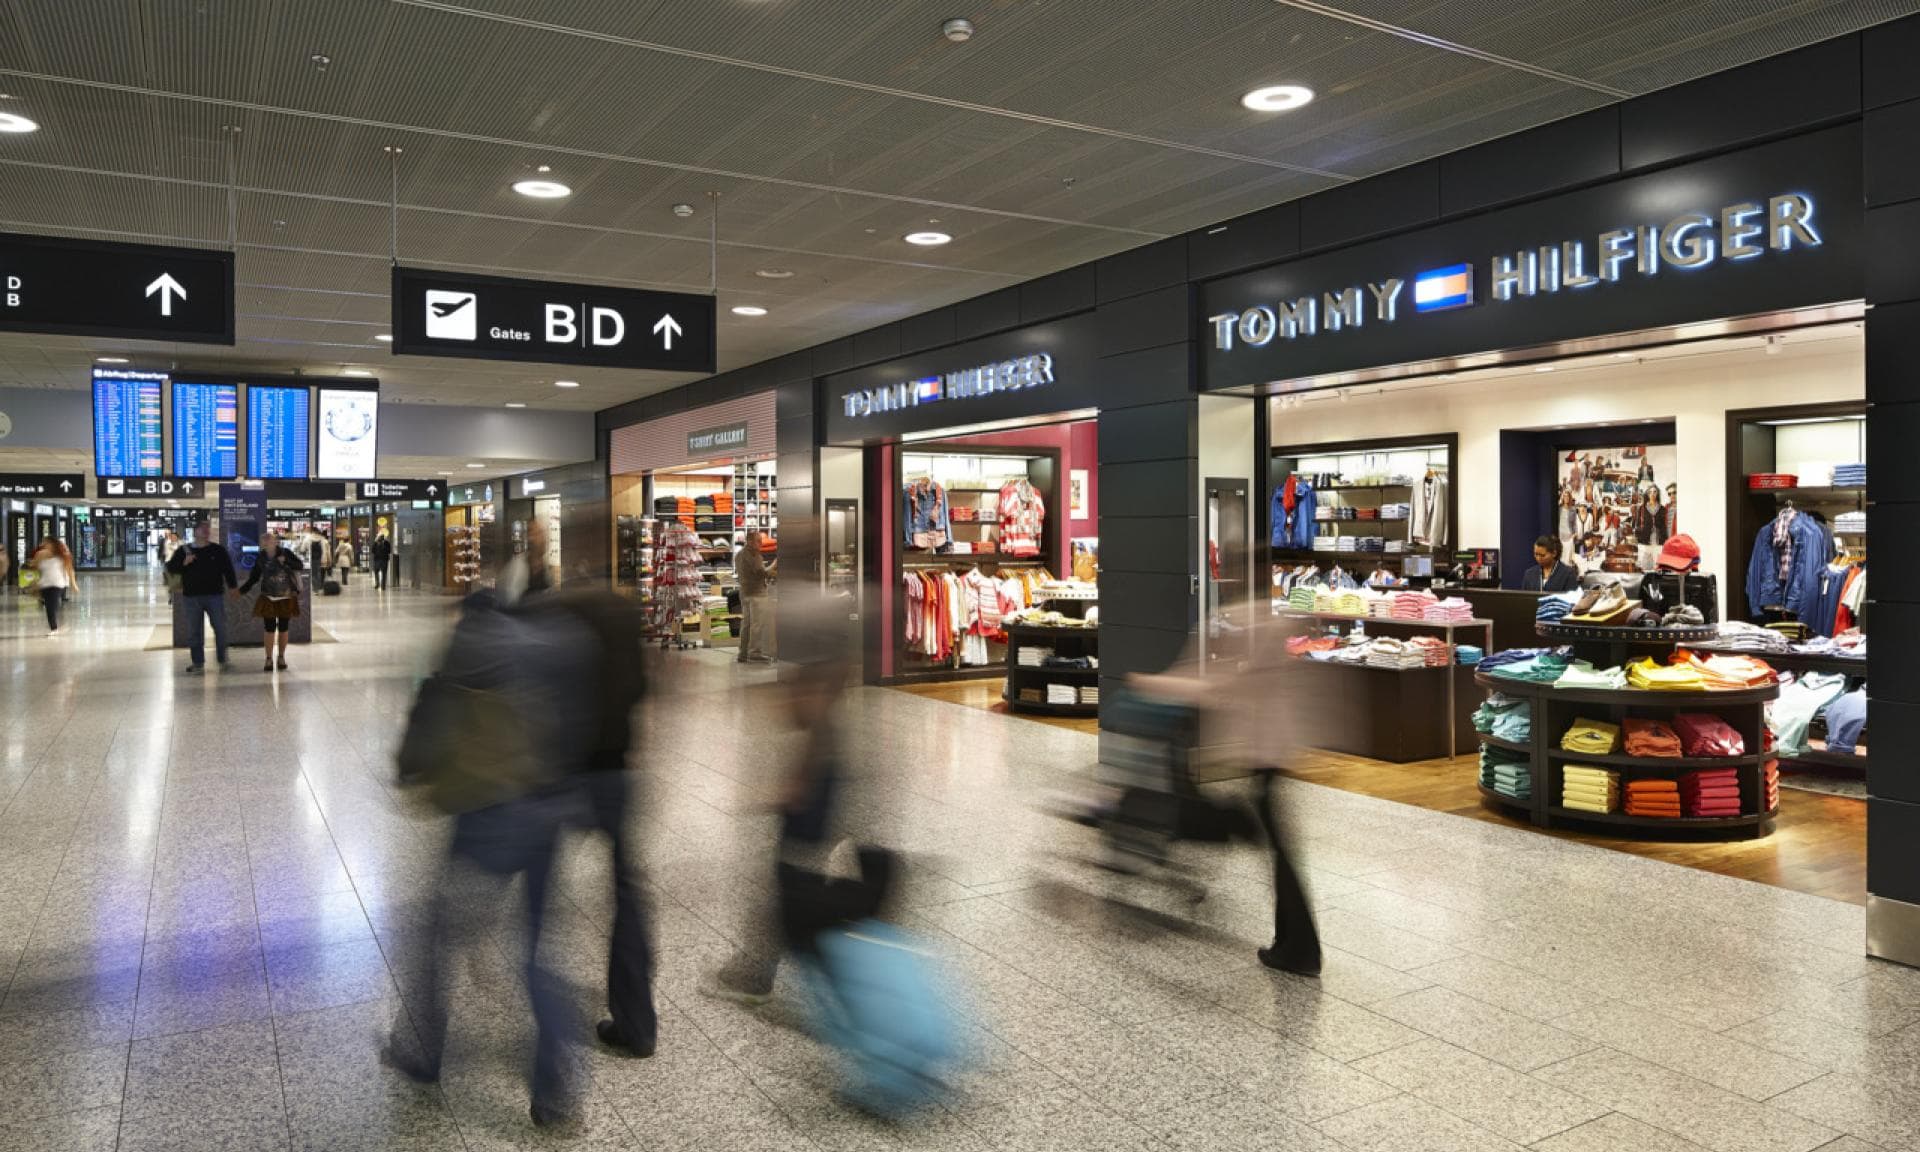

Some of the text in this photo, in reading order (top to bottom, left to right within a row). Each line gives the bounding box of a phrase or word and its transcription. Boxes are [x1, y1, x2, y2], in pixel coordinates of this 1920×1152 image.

[8, 276, 21, 289] D
[1209, 192, 1824, 351] TOMMY HILFIGER
[7, 293, 20, 307] B
[490, 303, 625, 346] Gates B D
[841, 352, 1054, 417] TOMMY HILFIGER
[145, 480, 157, 494] B
[161, 481, 174, 495] D
